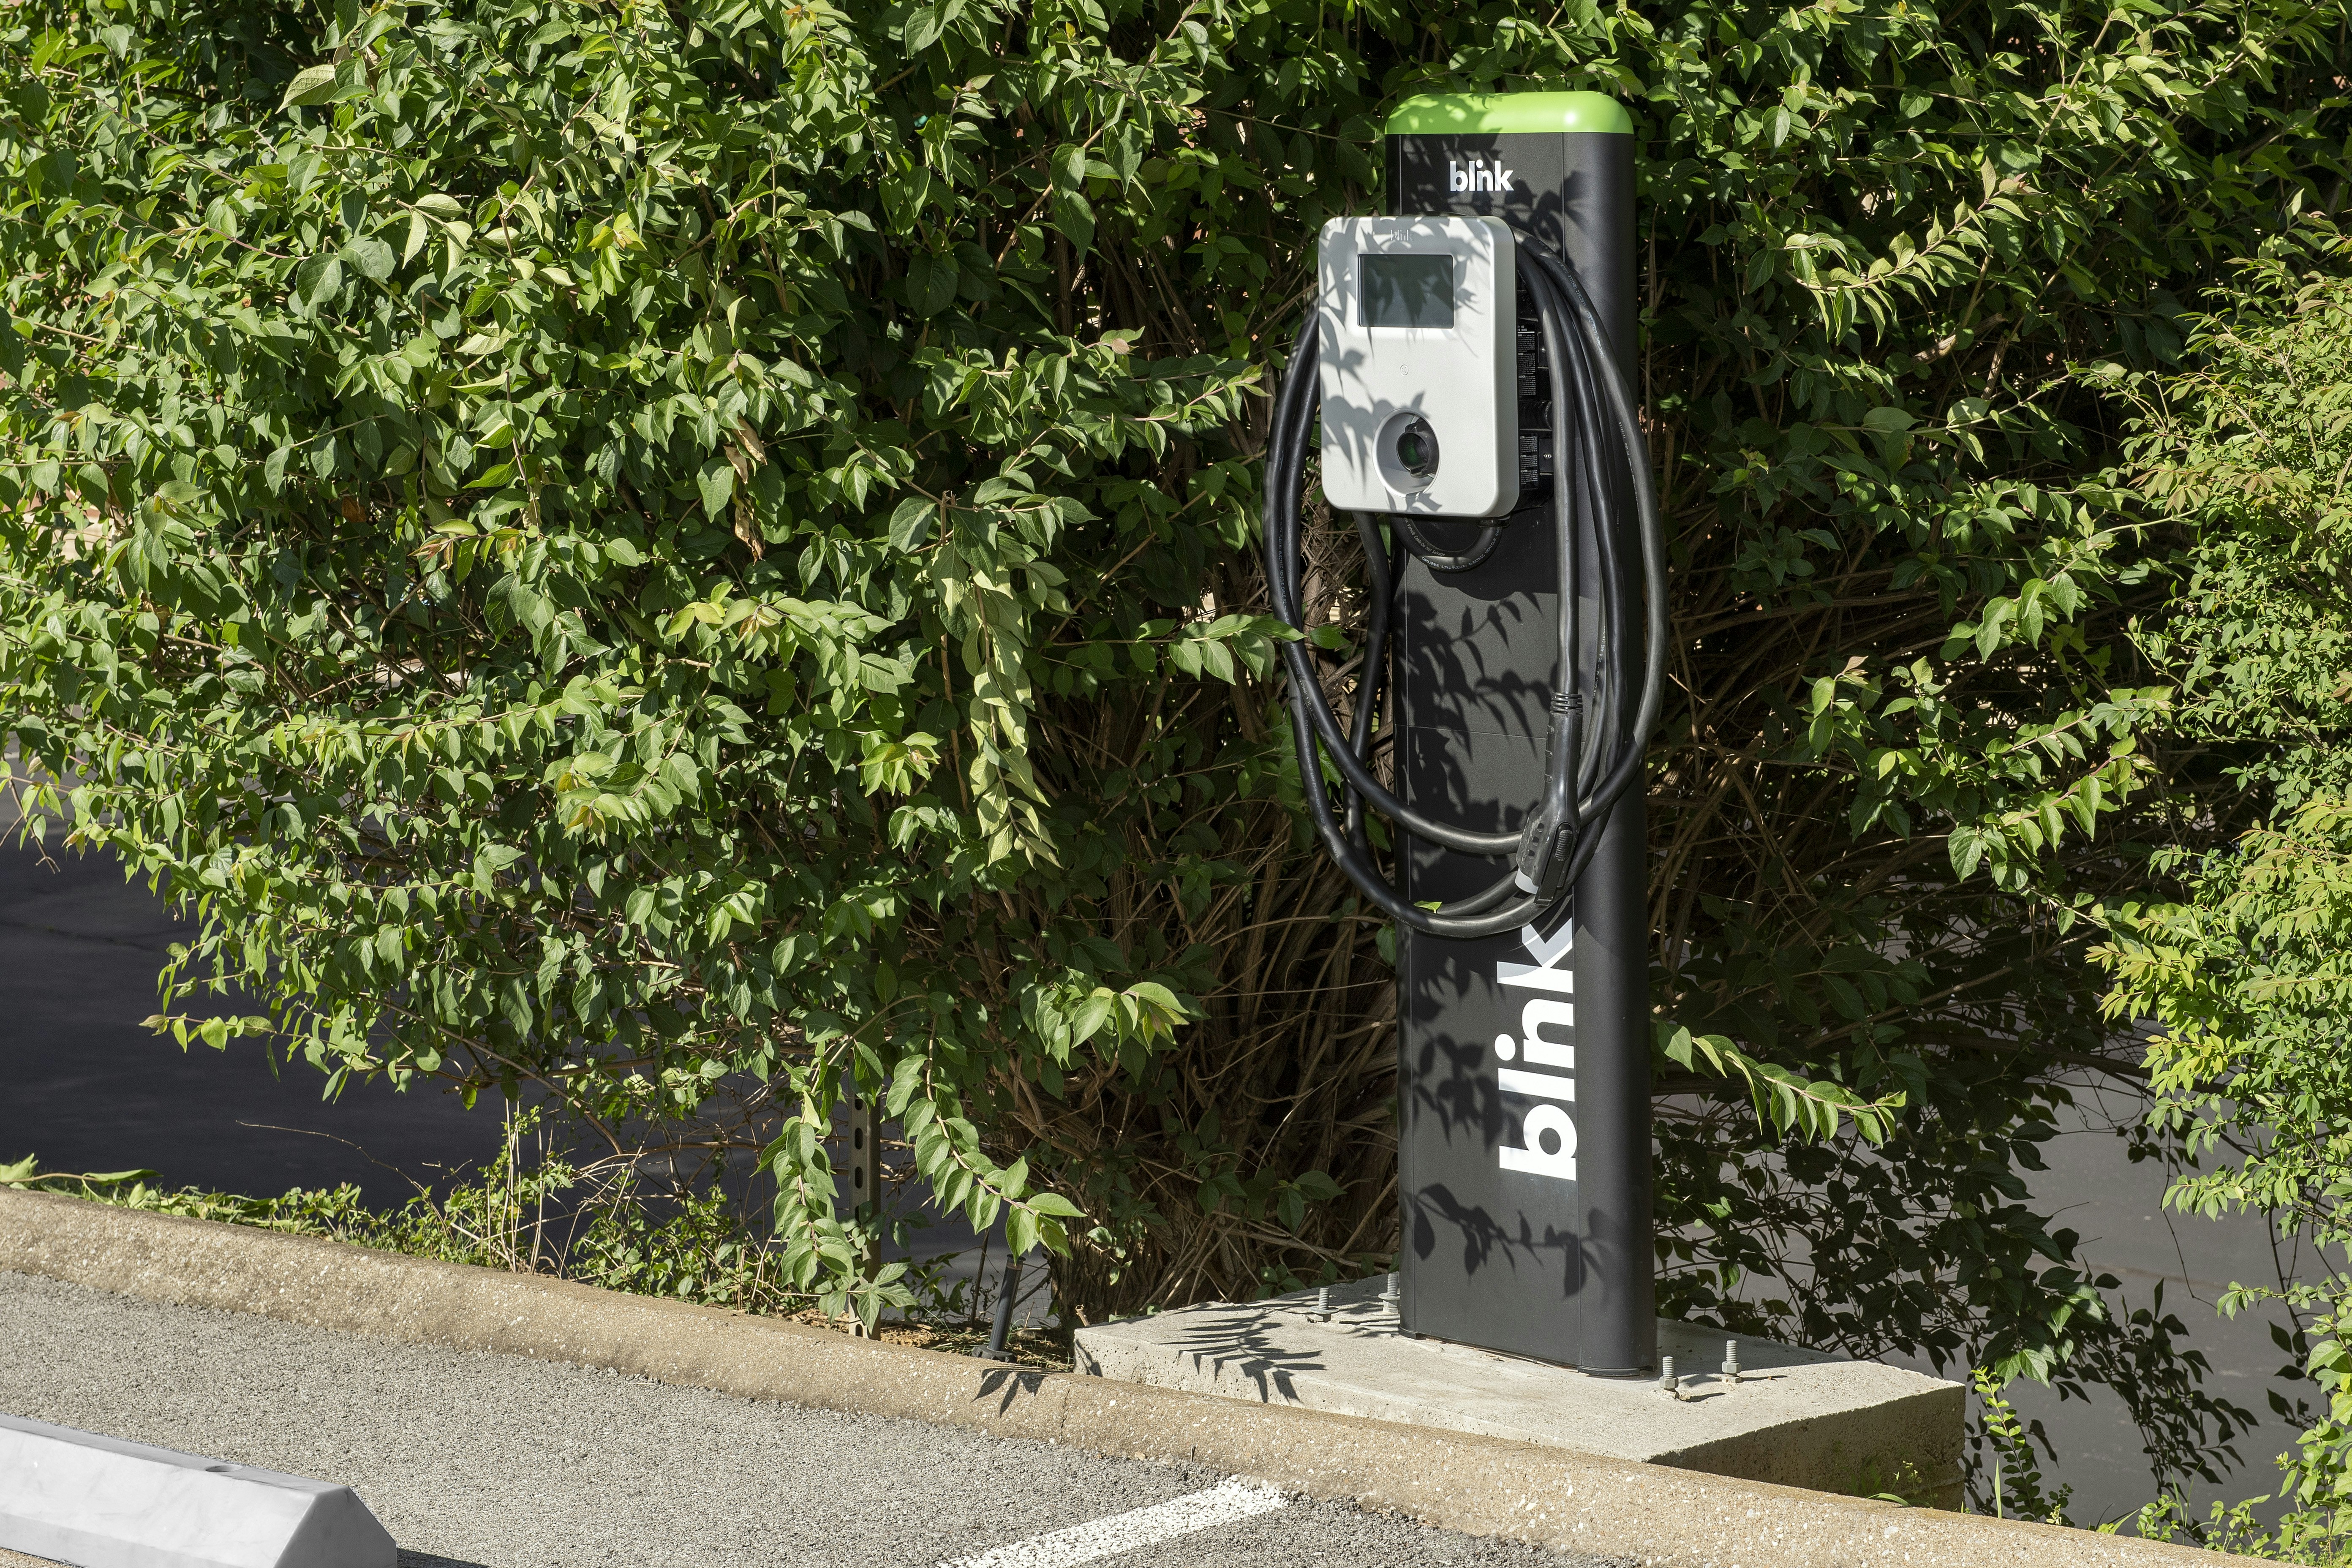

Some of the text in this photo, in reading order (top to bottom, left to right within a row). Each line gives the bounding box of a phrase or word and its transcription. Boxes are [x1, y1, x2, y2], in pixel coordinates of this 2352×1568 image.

[1450, 159, 1514, 192] blink
[1407, 523, 1415, 535] Vehicle
[1468, 554, 1486, 566] ELECTRIC
[1484, 538, 1497, 554] VEHICLE
[1494, 917, 1577, 1181] blink
